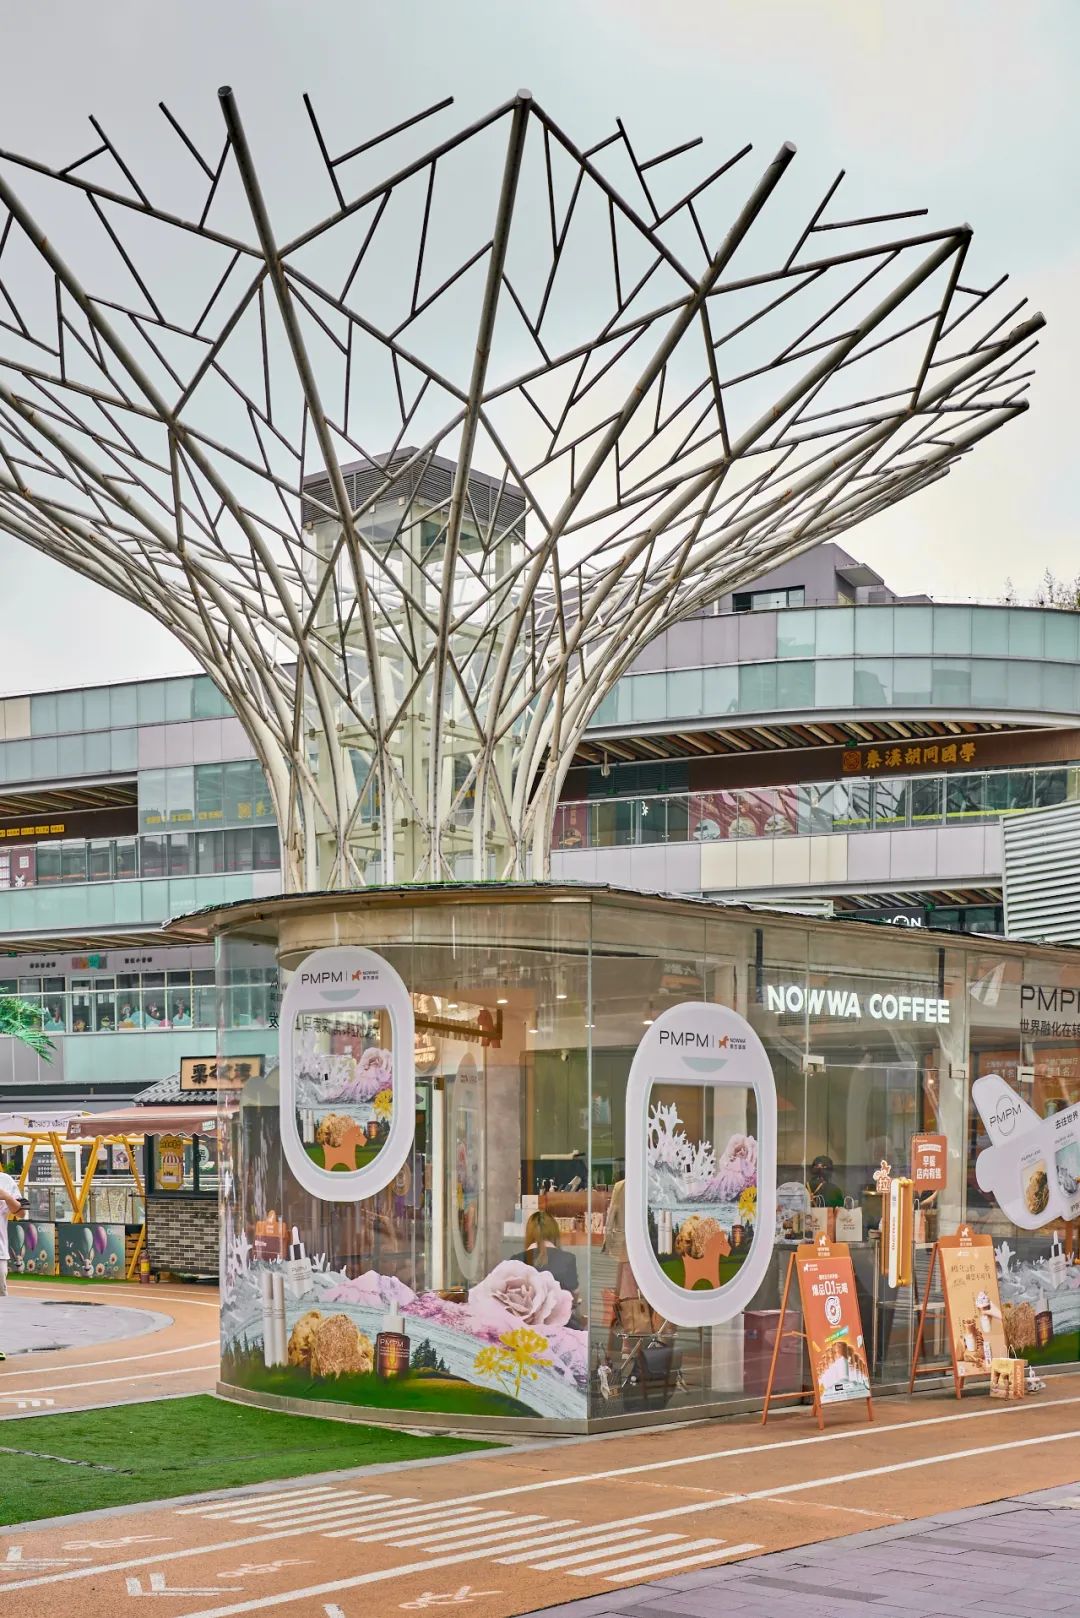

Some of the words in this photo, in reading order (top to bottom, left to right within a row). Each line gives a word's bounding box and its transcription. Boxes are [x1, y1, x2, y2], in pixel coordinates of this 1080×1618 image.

[301, 971, 343, 985] PMPM
[767, 985, 862, 1018] NOWWA
[869, 993, 950, 1024] COFFEE
[1020, 985, 1080, 1014] PMP
[659, 1030, 709, 1048] PMPM
[989, 1103, 1022, 1128] PMPM
